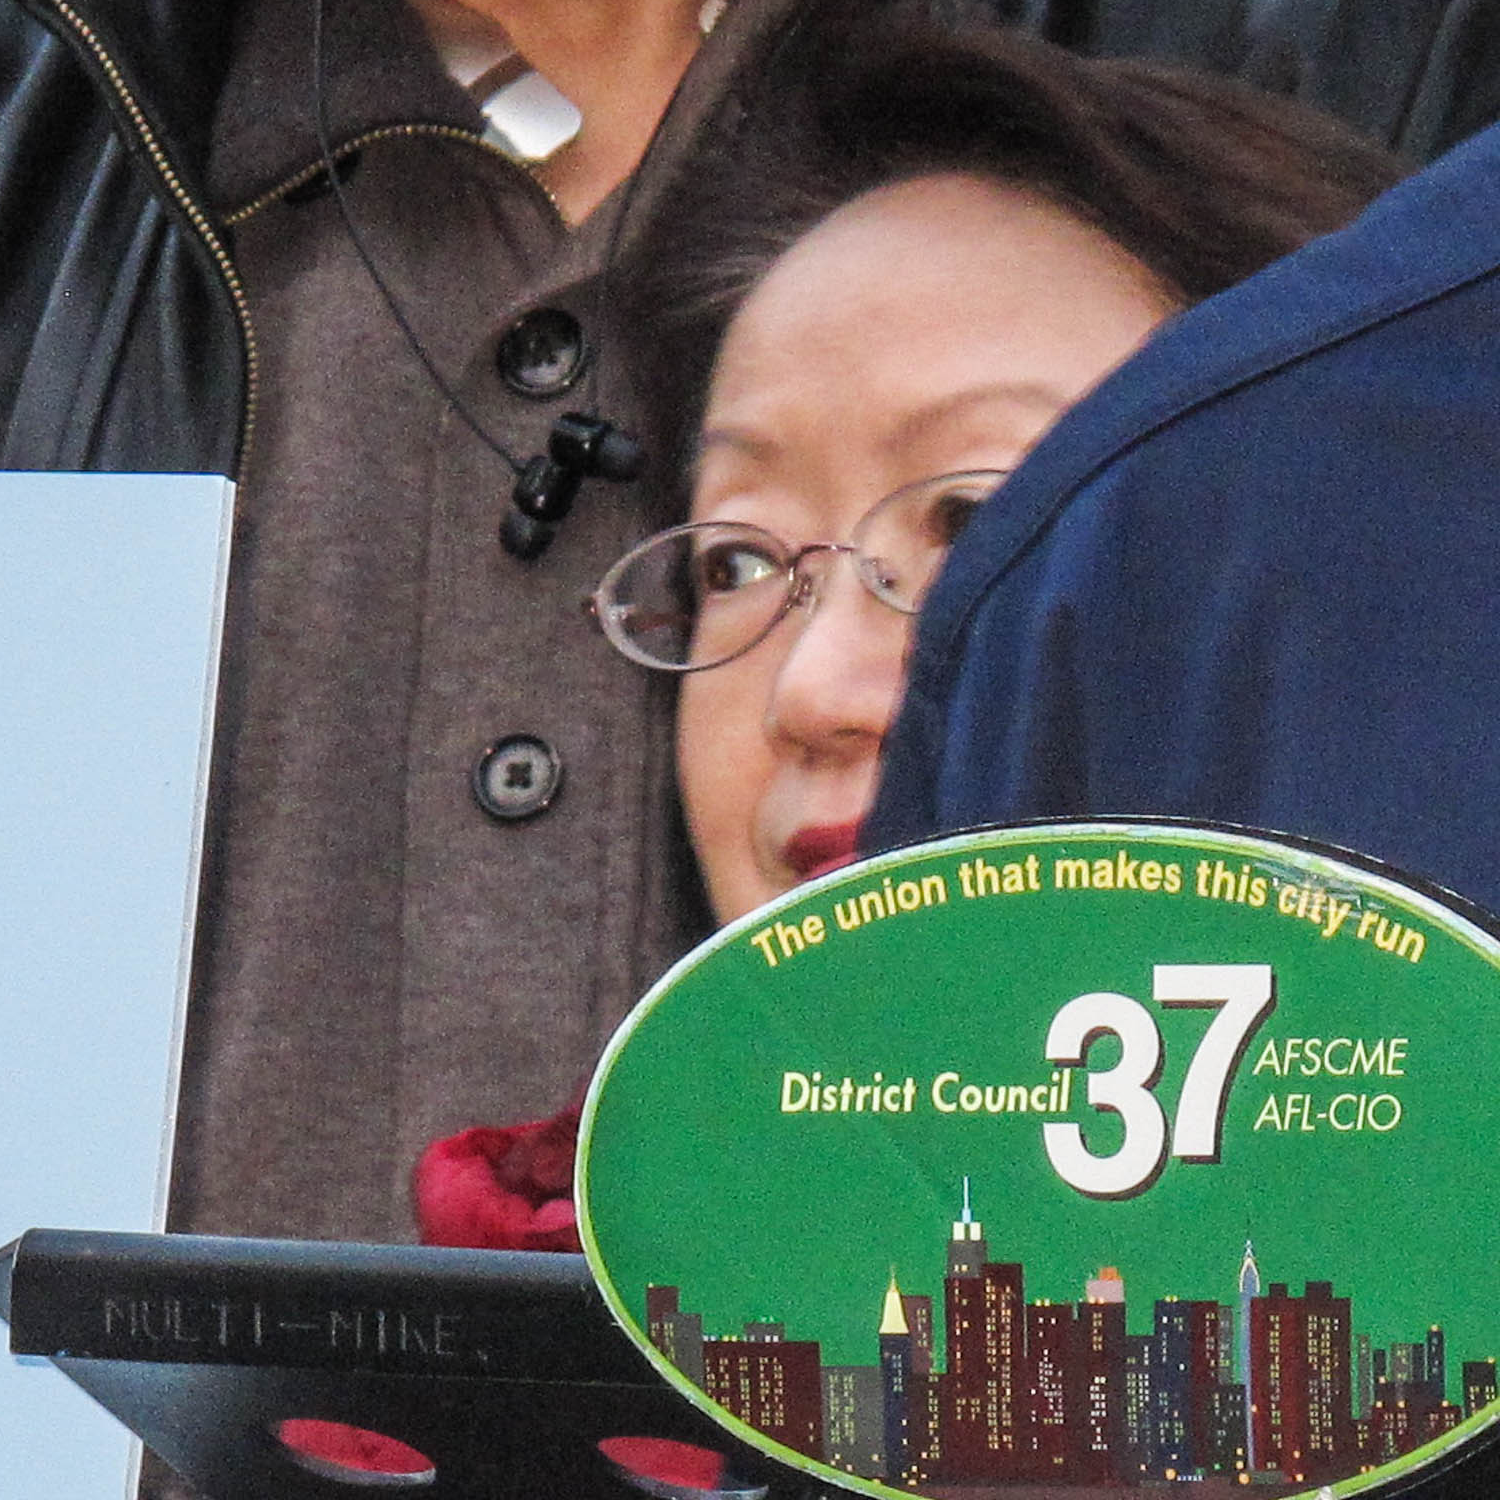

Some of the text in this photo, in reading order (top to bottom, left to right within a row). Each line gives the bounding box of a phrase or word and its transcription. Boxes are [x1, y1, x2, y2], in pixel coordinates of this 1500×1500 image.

[750, 851, 1428, 968] The union that makes this city run
[780, 963, 1278, 1202] District Council 37
[1253, 1037, 1409, 1077] AFSCME
[1253, 1093, 1403, 1133] AFL-CIO
